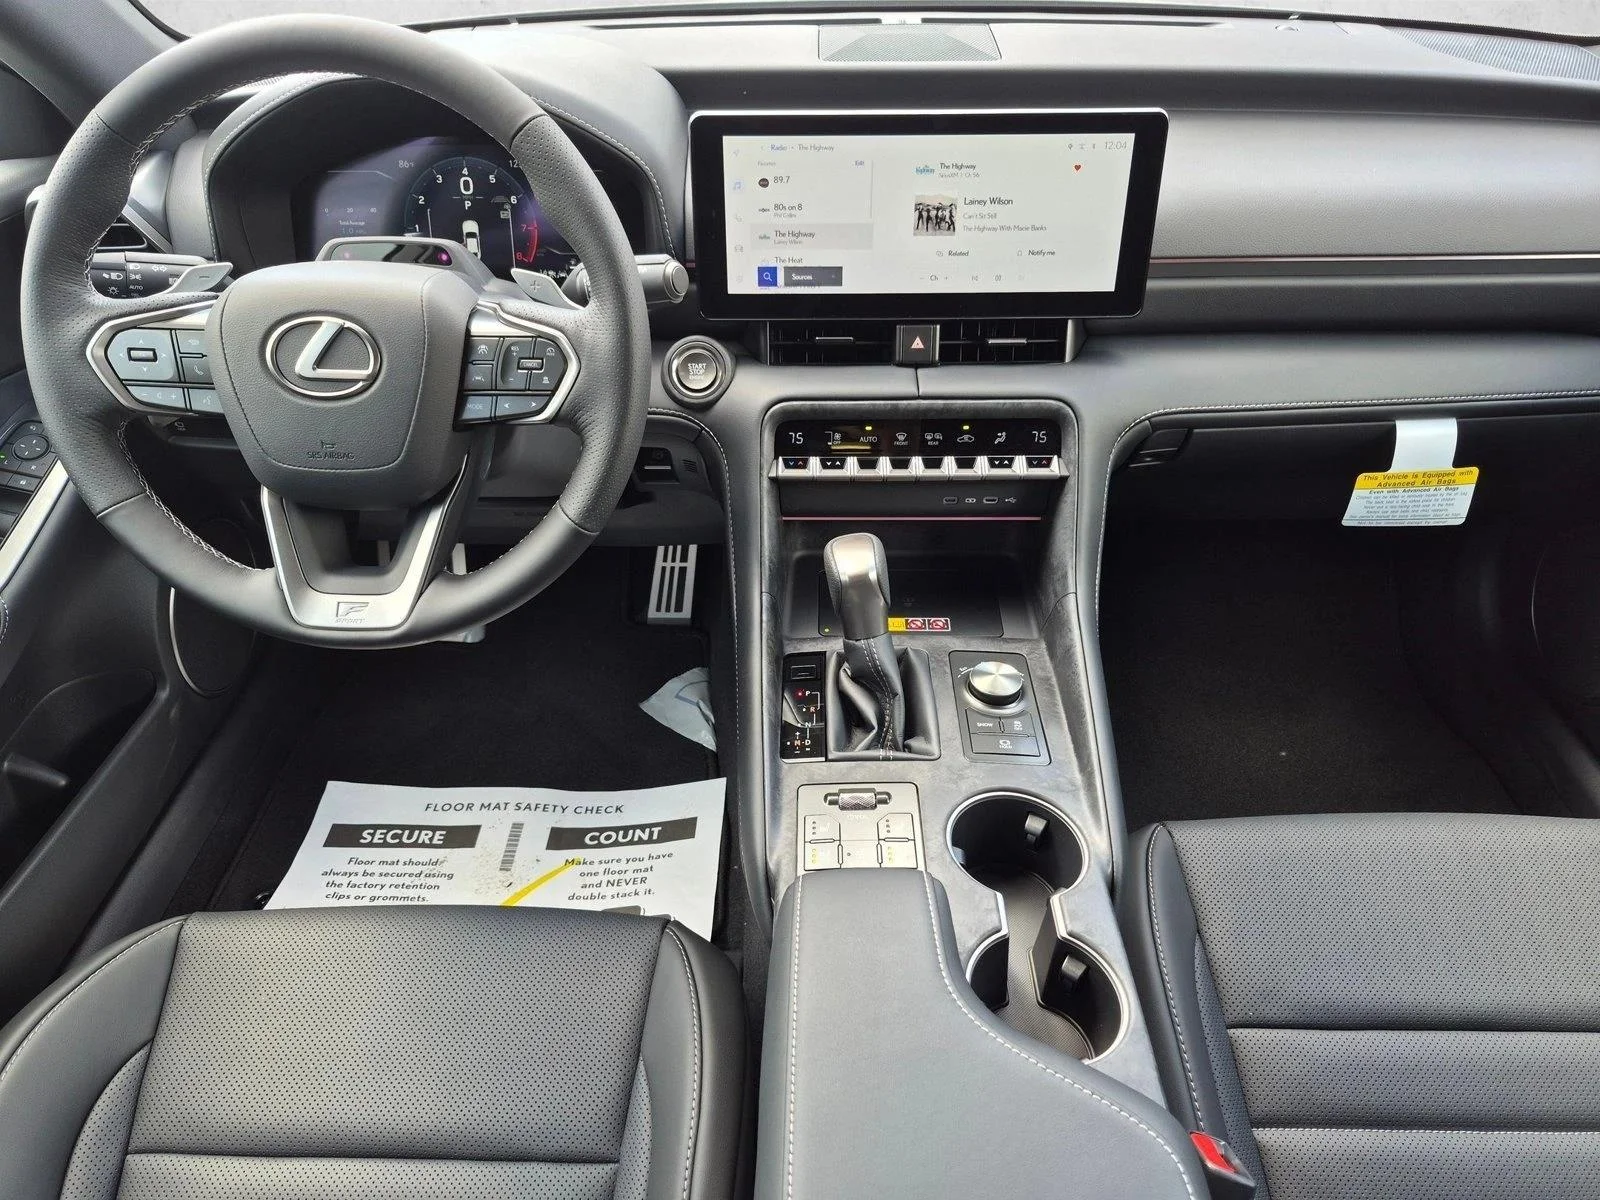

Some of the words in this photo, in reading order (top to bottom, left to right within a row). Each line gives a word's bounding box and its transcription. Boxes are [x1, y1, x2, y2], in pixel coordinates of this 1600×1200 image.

[810, 144, 834, 152] Highway
[1104, 141, 1127, 150] 12:04
[462, 167, 468, 175] 4
[951, 163, 976, 171] Highway
[436, 175, 442, 183] 3
[489, 175, 495, 183] 5
[773, 176, 790, 184] 89.7
[460, 176, 473, 194] 0
[418, 196, 425, 204] 2
[510, 196, 517, 204] 6
[964, 197, 987, 206] Lainey
[989, 197, 1013, 205] Wilson
[464, 201, 471, 210] P
[415, 224, 419, 232] 1
[521, 224, 527, 232] 7
[974, 225, 998, 233] Highway
[787, 230, 815, 239] Highway
[516, 252, 523, 260] 8
[789, 432, 803, 444] 75
[1032, 431, 1047, 442] 75
[306, 451, 322, 459] SRS
[323, 451, 355, 460] AIRBAG
[1382, 473, 1409, 481] Vehicle
[1422, 471, 1456, 480] Equipped
[424, 802, 475, 812] FLOOR
[479, 802, 512, 812] MAT
[515, 802, 569, 814] SAFETY
[574, 804, 625, 815] CHECK
[359, 829, 447, 845] SECURE
[584, 827, 662, 846] COUNT
[347, 857, 376, 866] Floor
[378, 858, 400, 866] mat
[402, 858, 439, 867] should
[564, 858, 595, 867] Make
[625, 856, 645, 864] you
[648, 852, 674, 861] have
[321, 868, 359, 879] always
[362, 869, 376, 878] be
[378, 869, 423, 879] secured
[424, 871, 455, 881] using
[603, 867, 629, 876] floor
[632, 865, 654, 874] mat
[325, 880, 344, 889] the
[346, 881, 387, 891] factory
[388, 882, 440, 891] retention
[580, 880, 602, 889] and
[606, 876, 648, 888] NEVER
[325, 892, 351, 901] clips
[369, 894, 430, 903] grommets.
[568, 893, 607, 901] double
[610, 889, 640, 899] stack
[644, 888, 656, 896] it.
